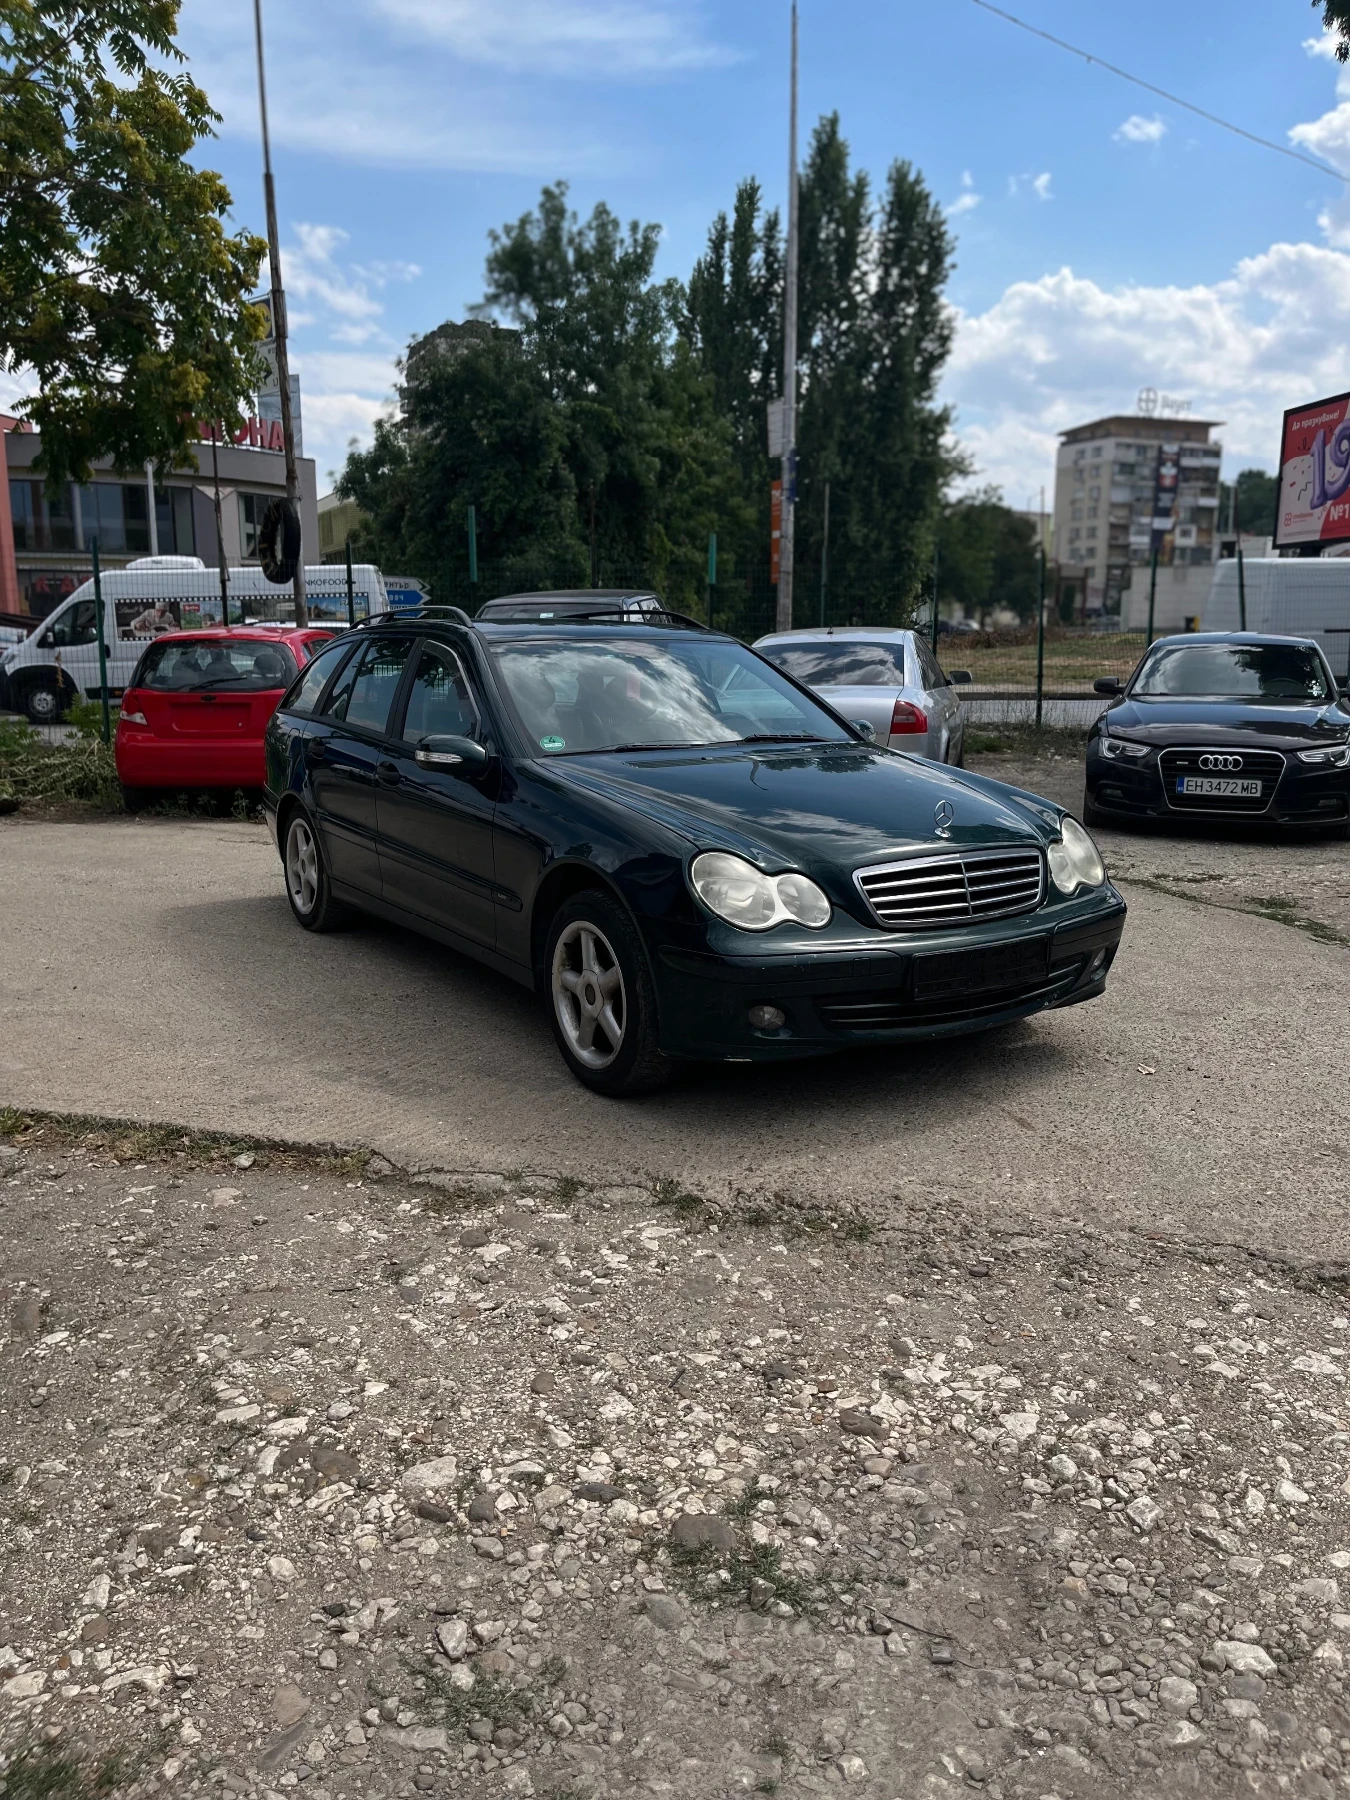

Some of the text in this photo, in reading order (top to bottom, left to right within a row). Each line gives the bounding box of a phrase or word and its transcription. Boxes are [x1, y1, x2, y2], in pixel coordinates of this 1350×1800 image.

[1292, 421, 1300, 431] Да
[305, 578, 348, 586] NKOFOOD
[384, 581, 409, 589] ентър
